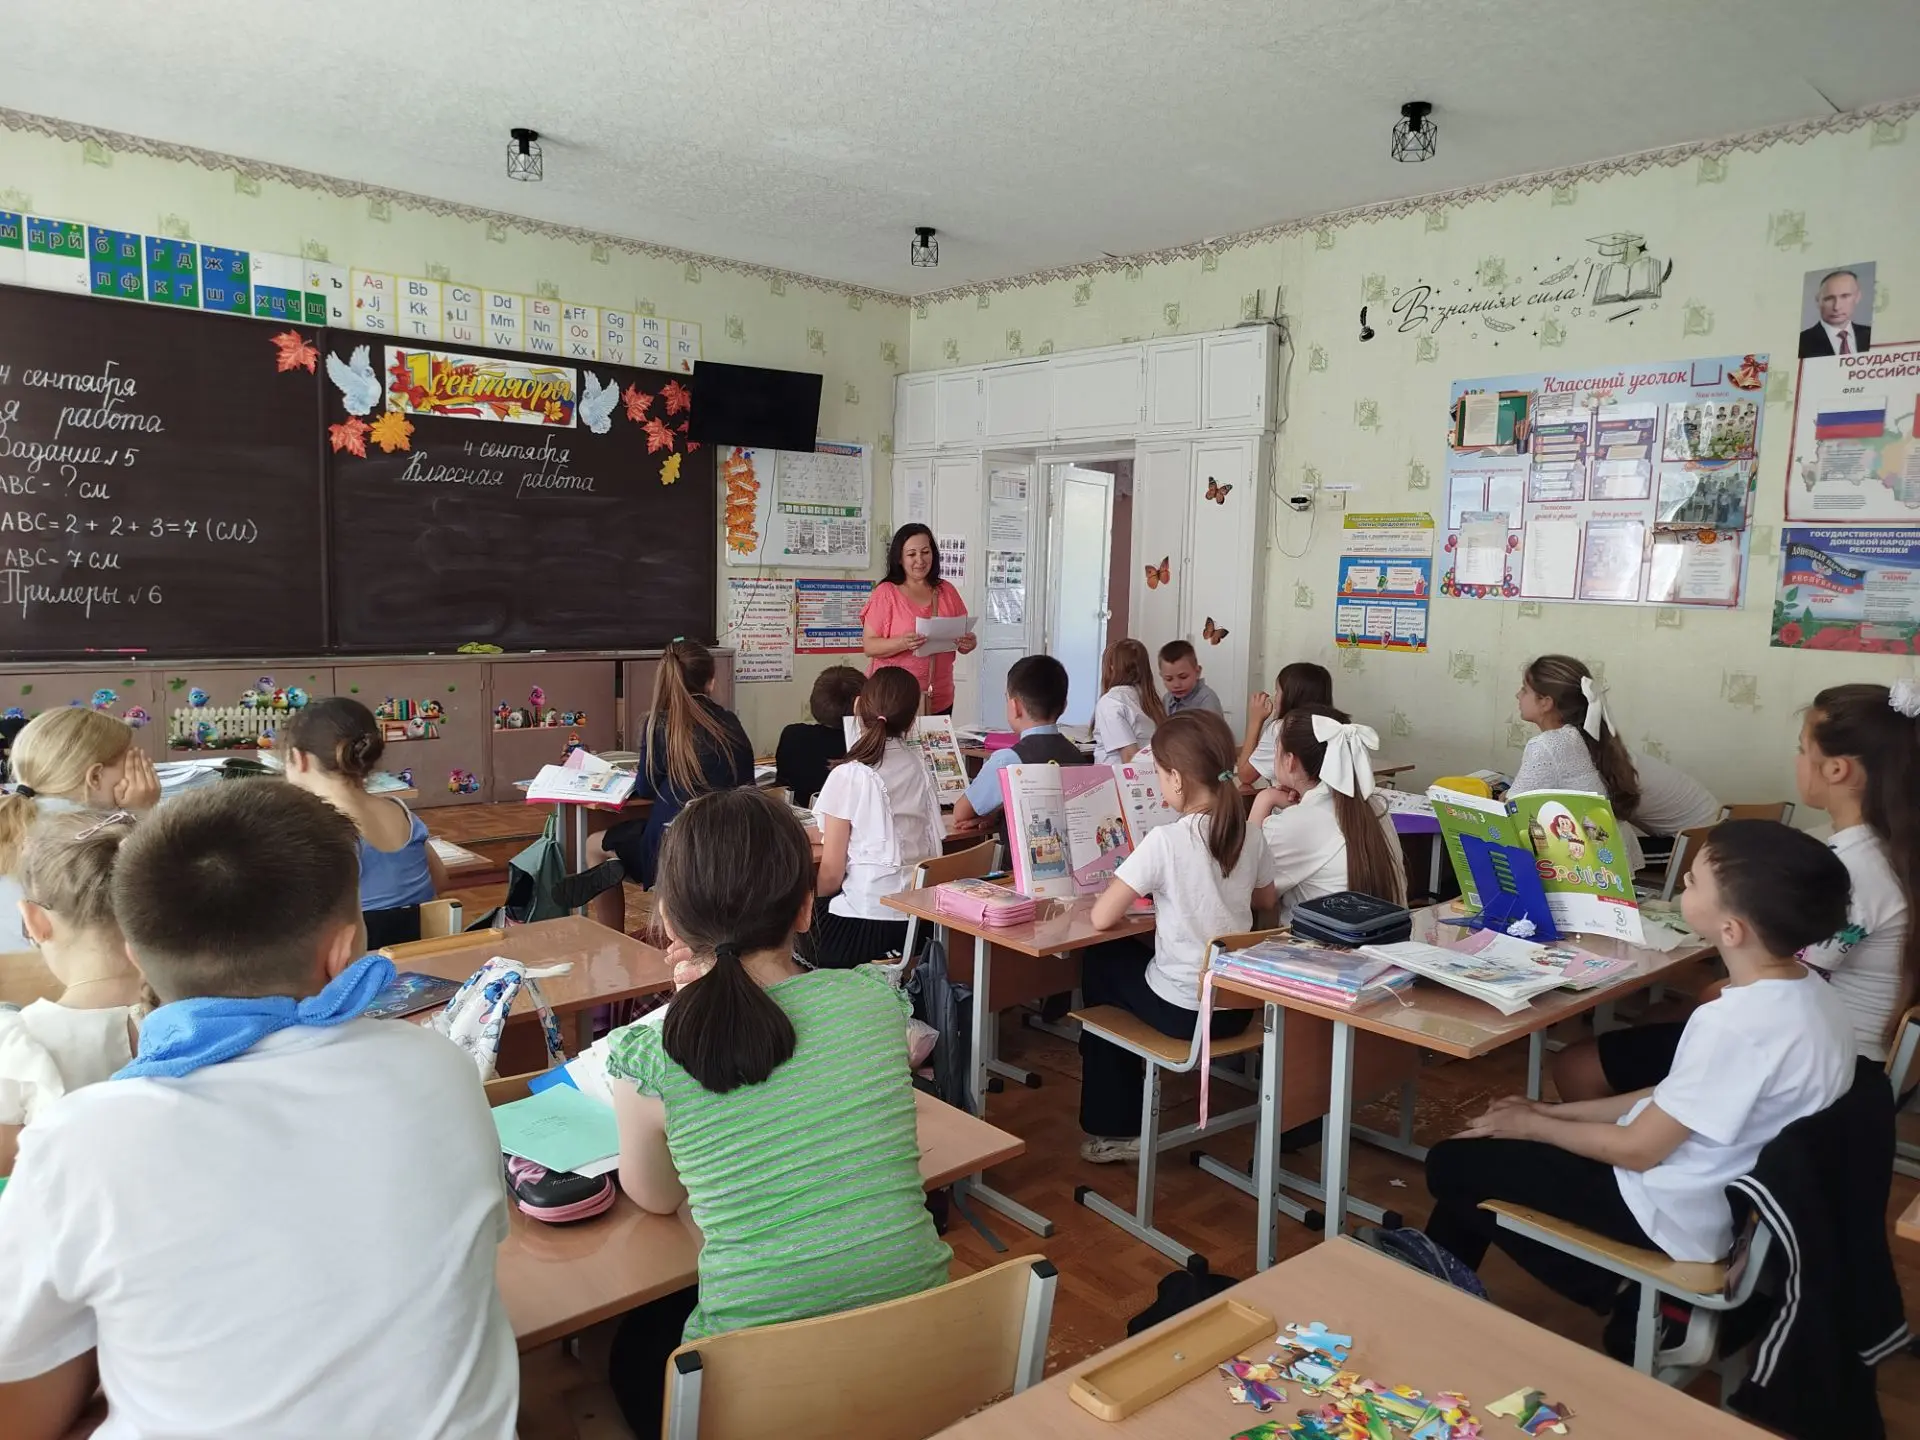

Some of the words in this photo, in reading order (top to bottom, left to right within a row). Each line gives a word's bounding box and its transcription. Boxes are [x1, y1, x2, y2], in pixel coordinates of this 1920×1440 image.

[30, 229, 44, 243] н
[50, 233, 64, 248] р
[68, 232, 82, 249] й
[96, 237, 109, 253] б
[123, 244, 136, 257] в
[154, 250, 165, 262] г
[177, 253, 193, 269] д
[205, 256, 223, 271] ж
[232, 262, 244, 274] з
[97, 272, 111, 285] п
[121, 273, 140, 292] ф
[154, 280, 168, 294] к
[180, 284, 192, 297] т
[331, 278, 343, 289] ъ
[206, 288, 224, 301] ш
[233, 291, 246, 304] с
[256, 295, 269, 307] х
[272, 297, 286, 312] ц
[288, 299, 300, 312] ч
[363, 275, 383, 290] Aa
[409, 282, 428, 296] Bb
[452, 288, 471, 302] Cc
[493, 295, 512, 308] Dd
[534, 301, 550, 314] Ee
[573, 308, 586, 320] Ff
[607, 313, 624, 328] Gg
[643, 319, 658, 331] Hh
[333, 308, 342, 318] ь
[1392, 286, 1431, 333] В
[1431, 295, 1521, 333] знаниях
[369, 296, 380, 311] Jj
[410, 302, 428, 316] Kk
[456, 308, 467, 321] Ll
[491, 313, 514, 327] Mm
[533, 320, 550, 333] Nn
[571, 325, 588, 338] Oo
[608, 331, 623, 344] Pp
[643, 336, 659, 350] Qq
[678, 342, 690, 352] Rr
[366, 315, 384, 329] Ss
[412, 321, 426, 335] Tt
[453, 327, 471, 341] Uu
[494, 332, 512, 346] Vv
[531, 337, 553, 351] Ww
[572, 343, 587, 356] Xx
[608, 348, 623, 363] Yy
[644, 353, 658, 365] Zz
[23, 360, 136, 408] сентября
[405, 352, 433, 413] 1
[432, 367, 574, 410] сентября
[1543, 372, 1625, 393] Классный
[1627, 371, 1687, 394] уголок
[54, 399, 165, 440] работа
[463, 440, 473, 455] 4
[480, 434, 571, 473] сентября
[402, 451, 504, 485] Классная
[517, 465, 596, 499] работа
[1792, 546, 1826, 562] ДОНЕЦКАЯ
[0, 569, 121, 619] Примеры
[1536, 858, 1625, 893] Spotlight
[1613, 907, 1627, 926] 3
